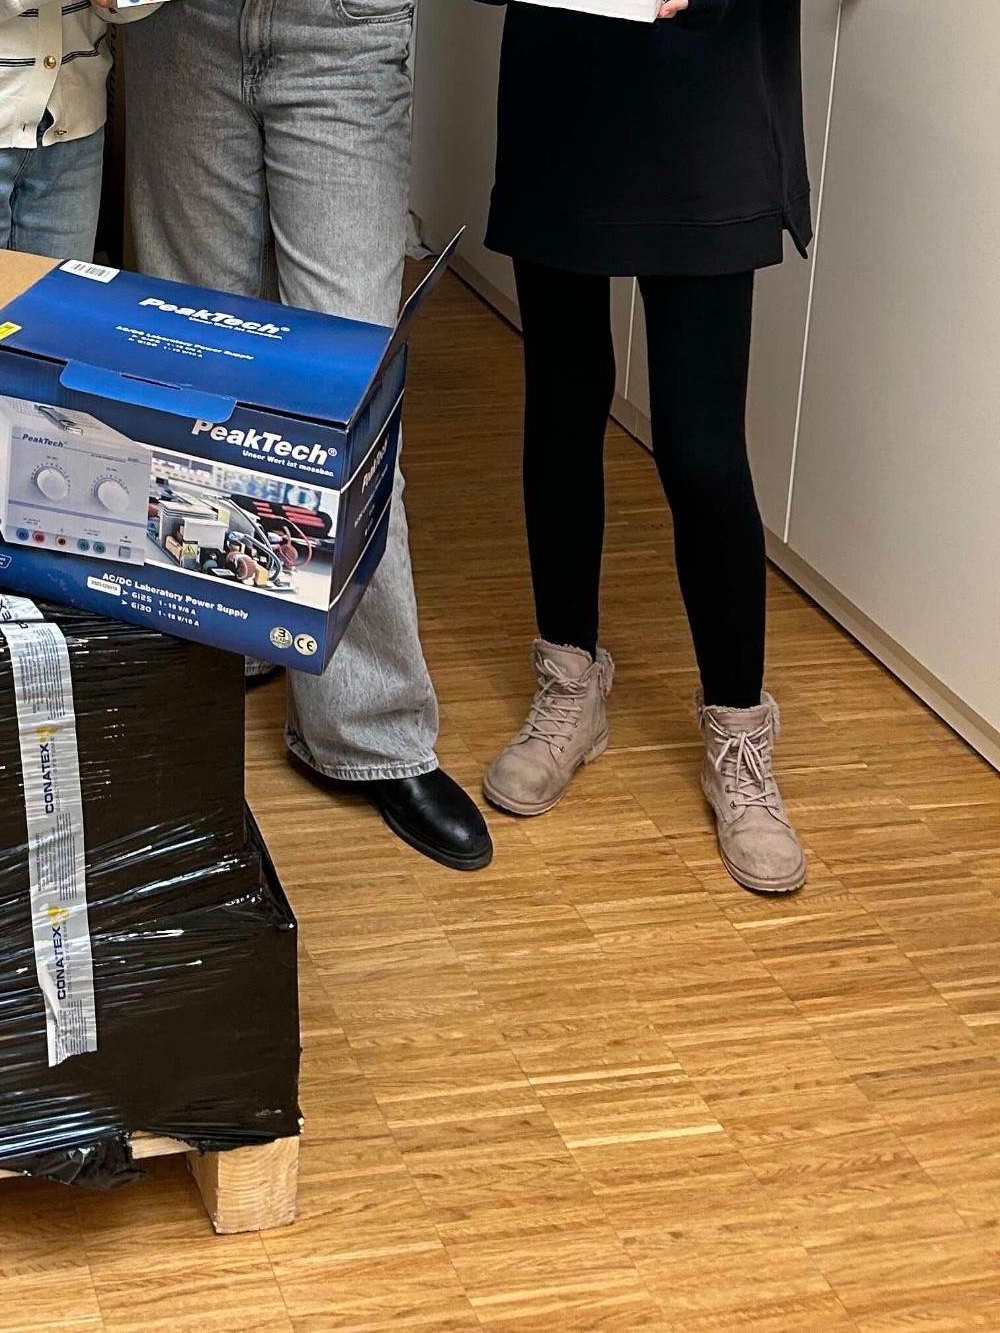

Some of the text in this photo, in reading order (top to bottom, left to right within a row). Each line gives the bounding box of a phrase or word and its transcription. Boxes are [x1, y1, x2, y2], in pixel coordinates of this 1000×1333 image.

[102, 572, 132, 587] AC/DC
[134, 581, 183, 602] Laboratory
[185, 595, 215, 610] Power
[217, 603, 249, 620] Supply
[39, 743, 55, 814] CONATEX
[52, 926, 66, 1001] CONATEX
